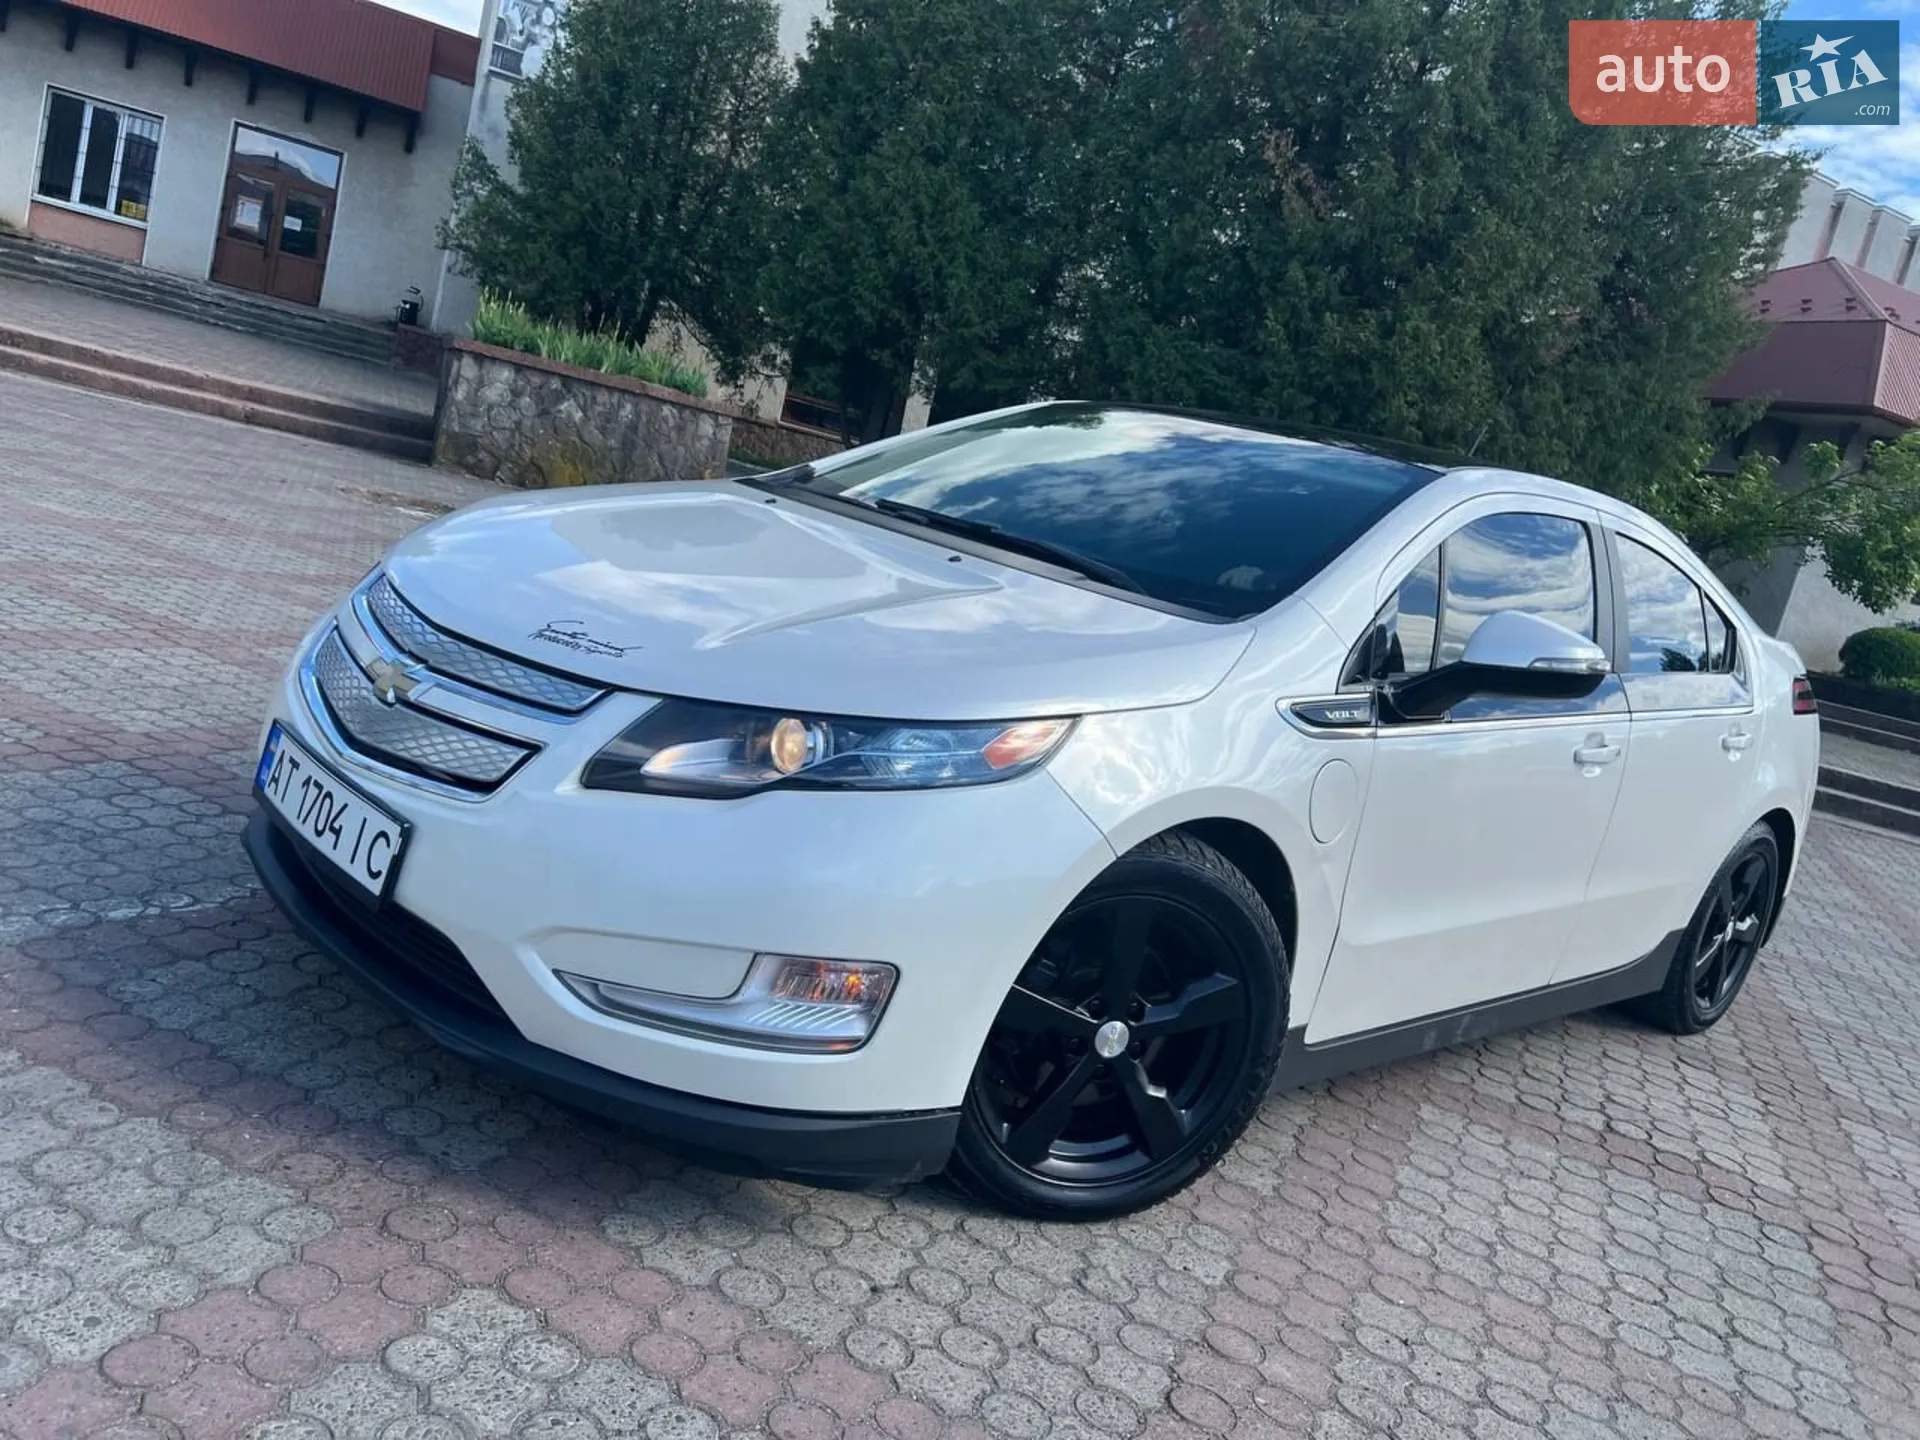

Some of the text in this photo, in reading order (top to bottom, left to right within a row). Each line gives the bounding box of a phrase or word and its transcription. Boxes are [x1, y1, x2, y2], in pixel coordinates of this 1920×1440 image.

[1324, 710, 1359, 719] VOLT
[267, 749, 391, 880] AT 1704 IC
